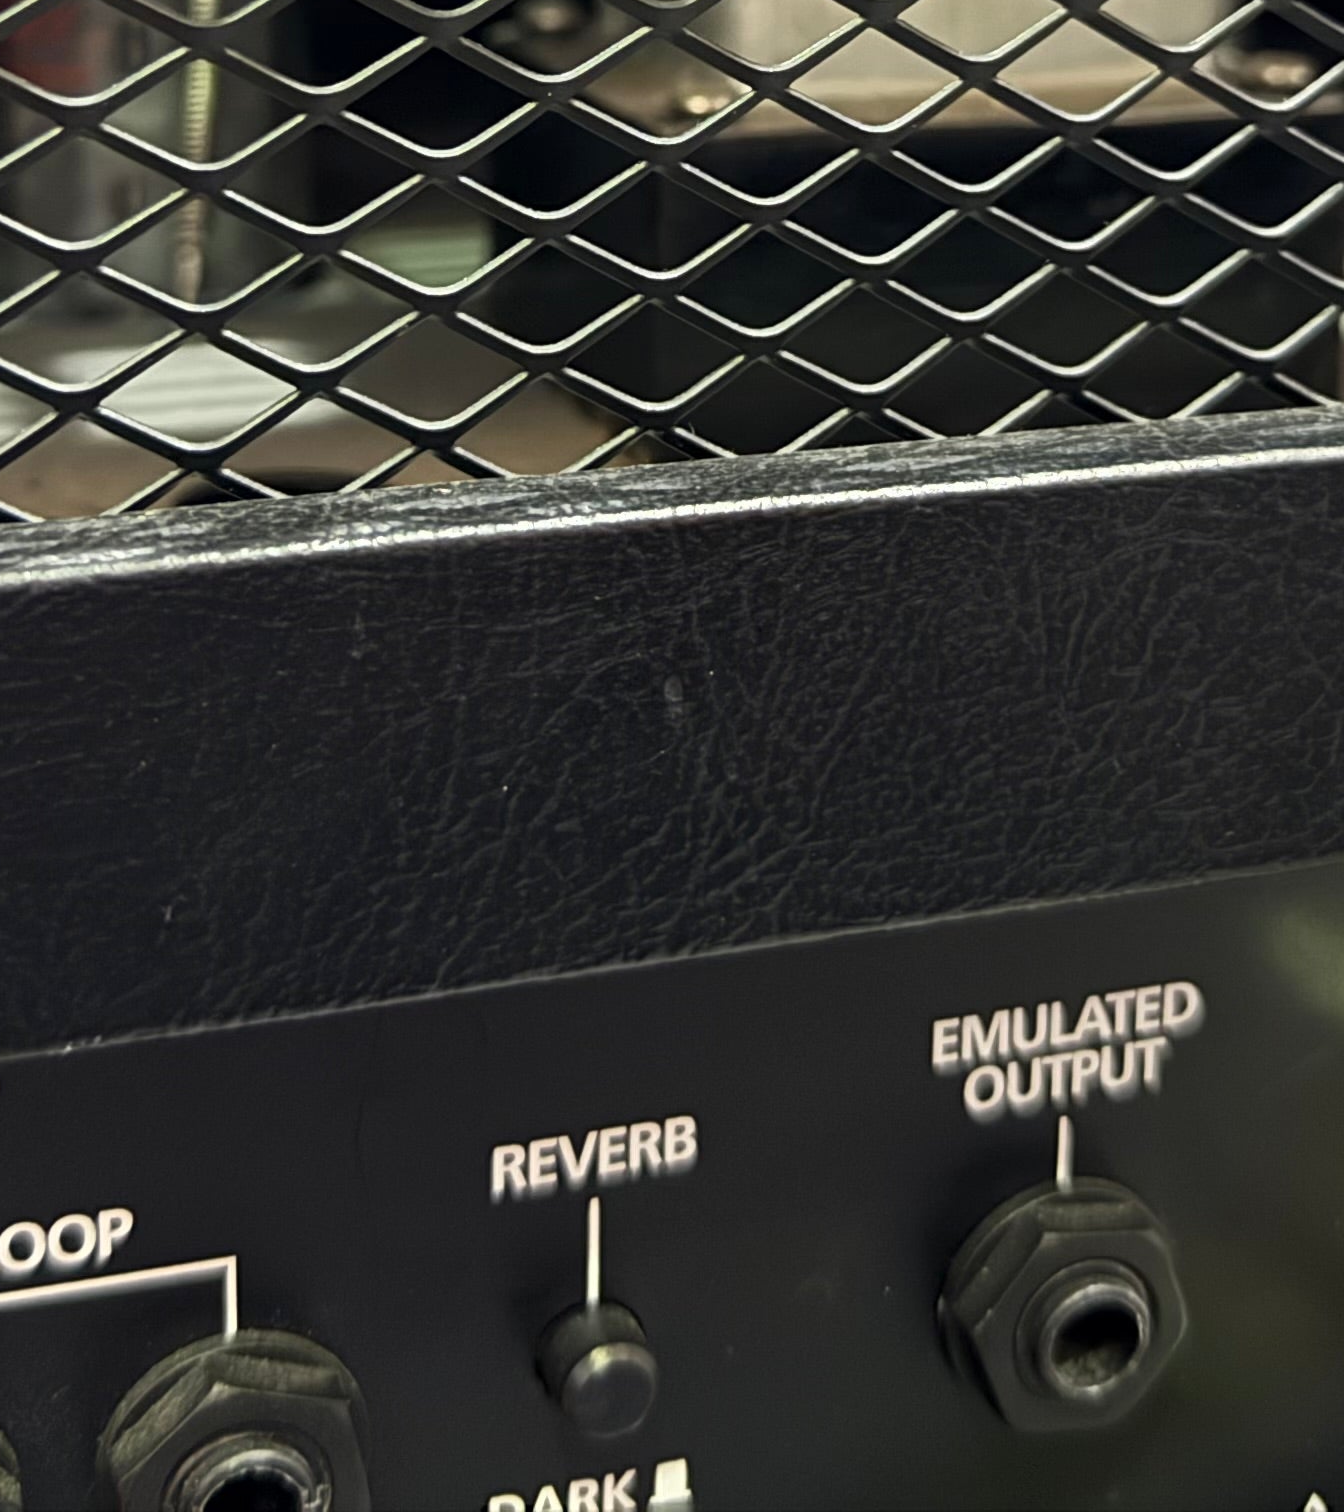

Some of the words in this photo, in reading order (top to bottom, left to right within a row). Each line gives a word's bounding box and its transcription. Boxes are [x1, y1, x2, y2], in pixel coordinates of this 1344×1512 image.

[931, 981, 1204, 1072] EMULATED
[963, 1036, 1170, 1120] OUTPUT
[490, 1114, 699, 1202] REVERB
